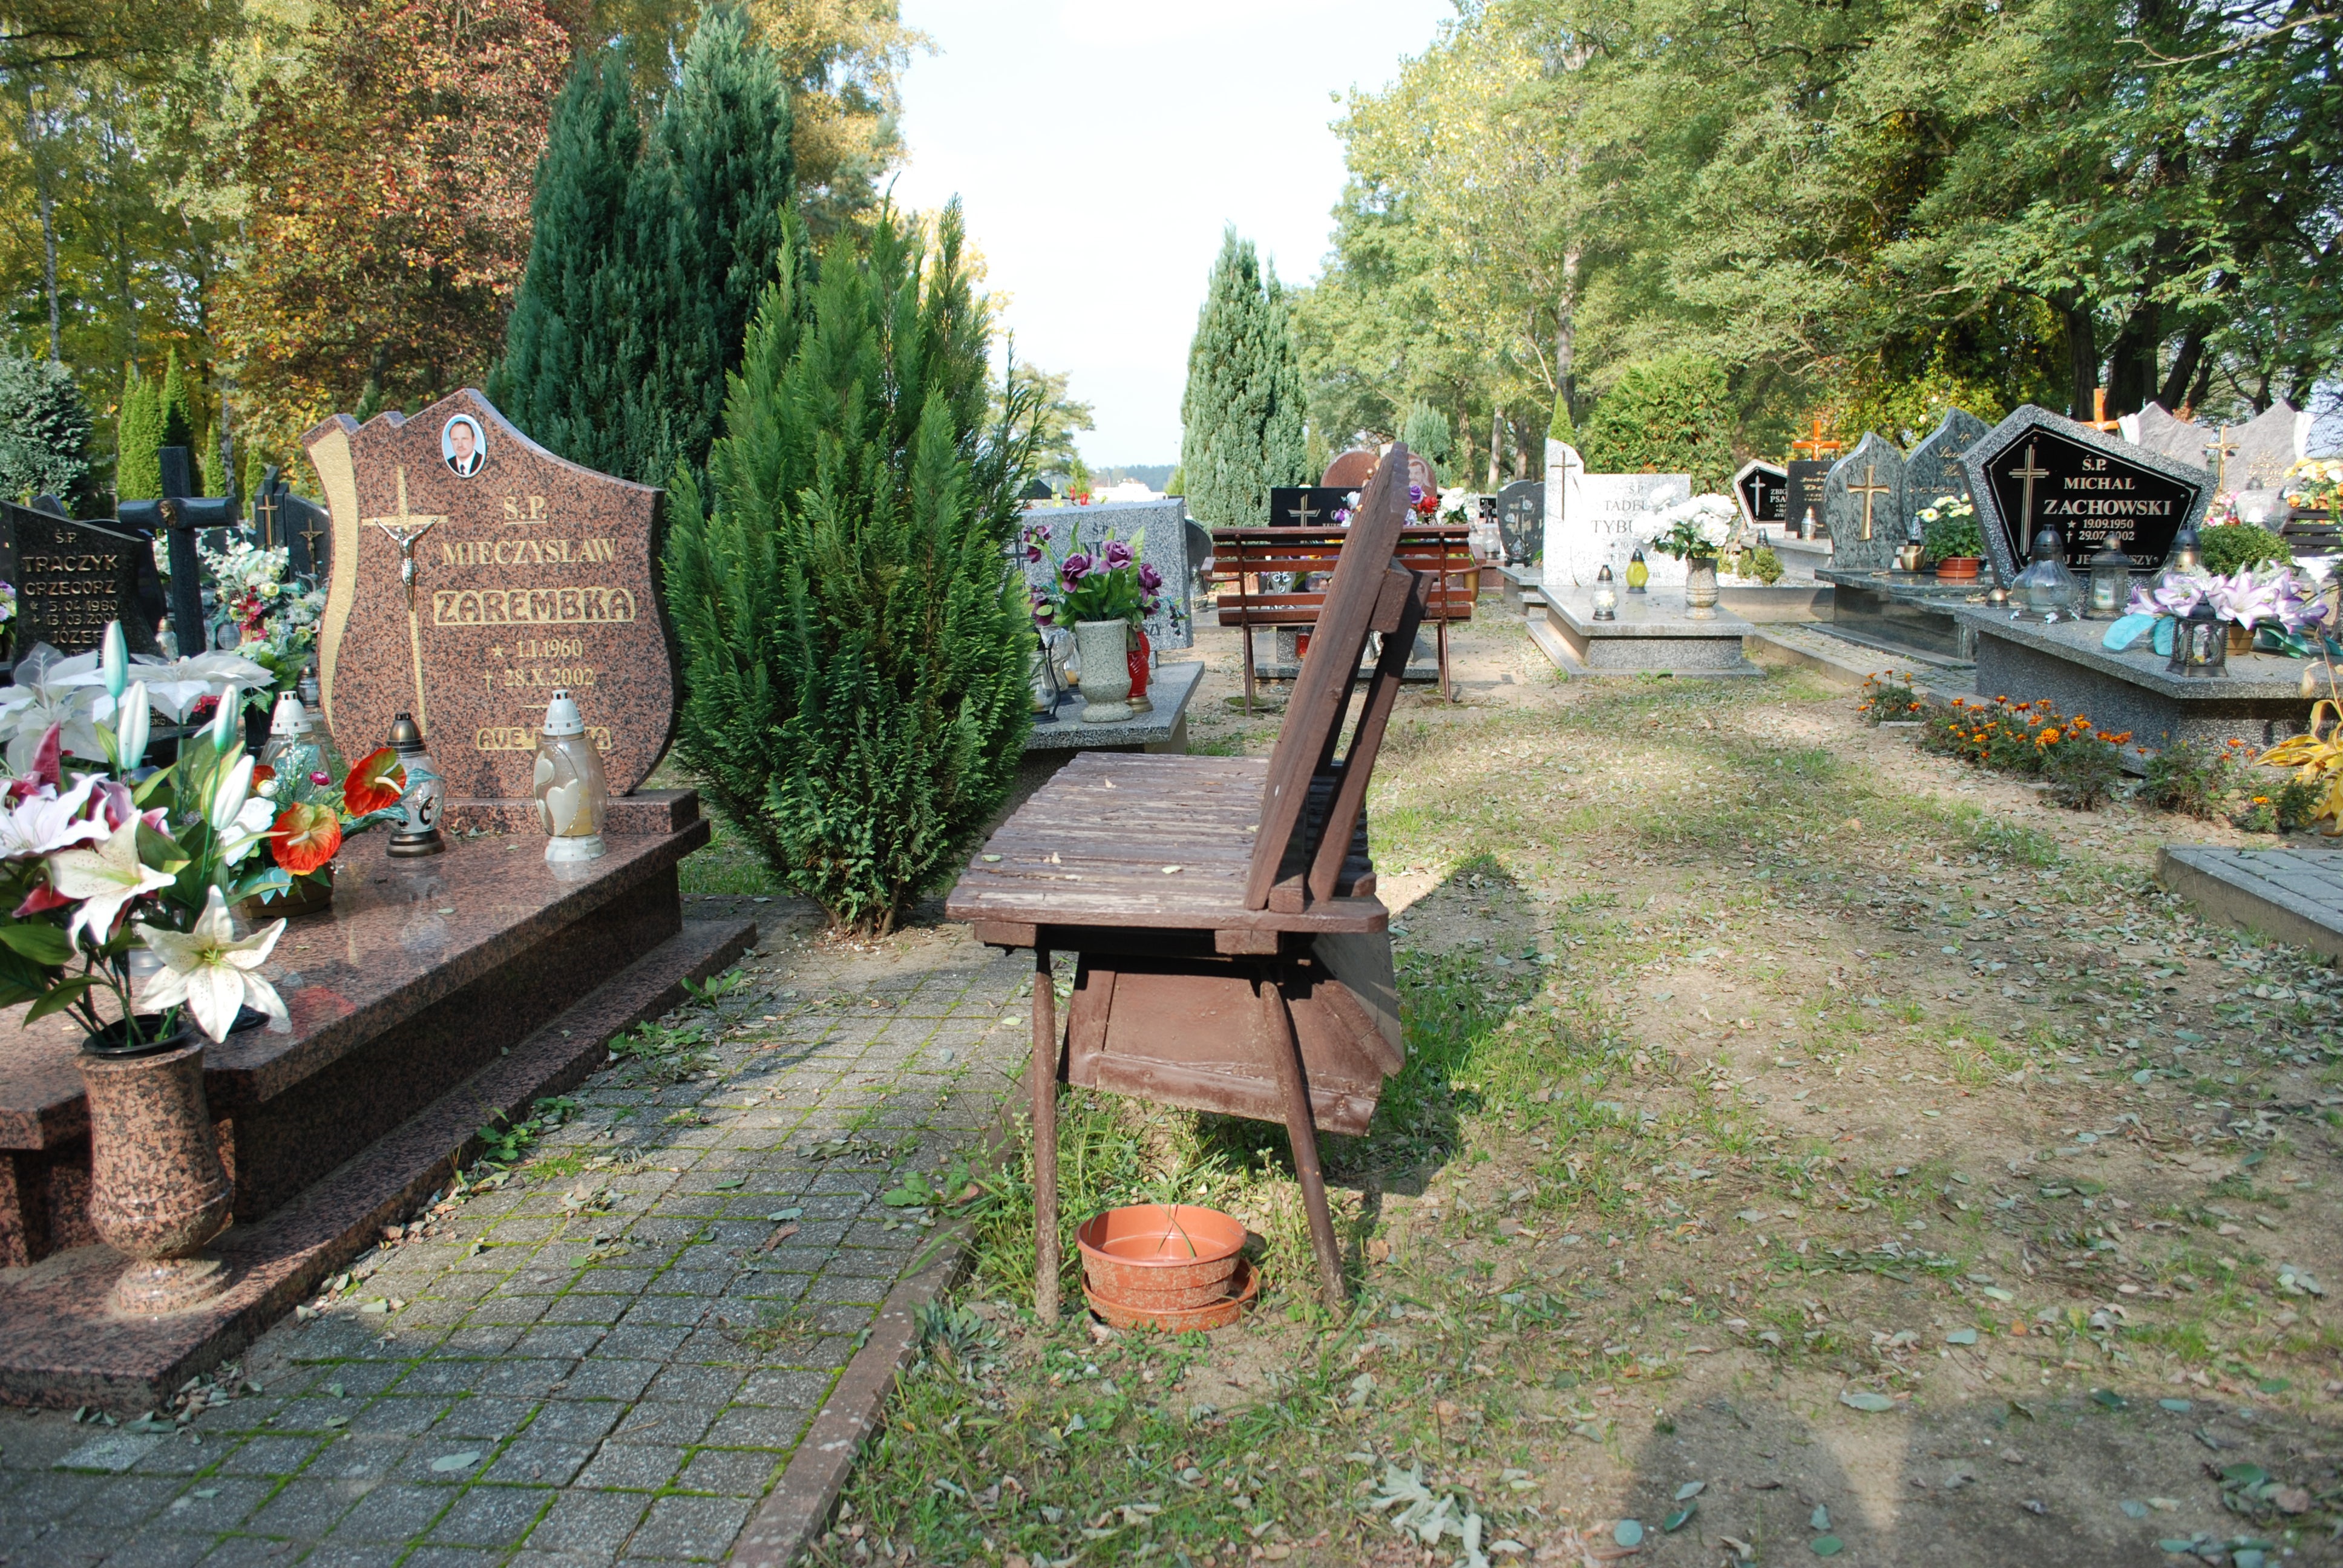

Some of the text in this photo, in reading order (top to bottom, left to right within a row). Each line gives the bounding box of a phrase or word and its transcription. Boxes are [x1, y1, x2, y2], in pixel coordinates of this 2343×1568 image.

[2082, 455, 2107, 471] Ś.P.
[504, 488, 548, 520] Ś.P.
[2043, 500, 2171, 515] ZACHOWSKI
[2083, 519, 2134, 529] 19.09.1950
[22, 555, 119, 572] TRACZYK
[433, 586, 636, 626] ZAREMBKA
[504, 667, 594, 687] 28.X.2002
